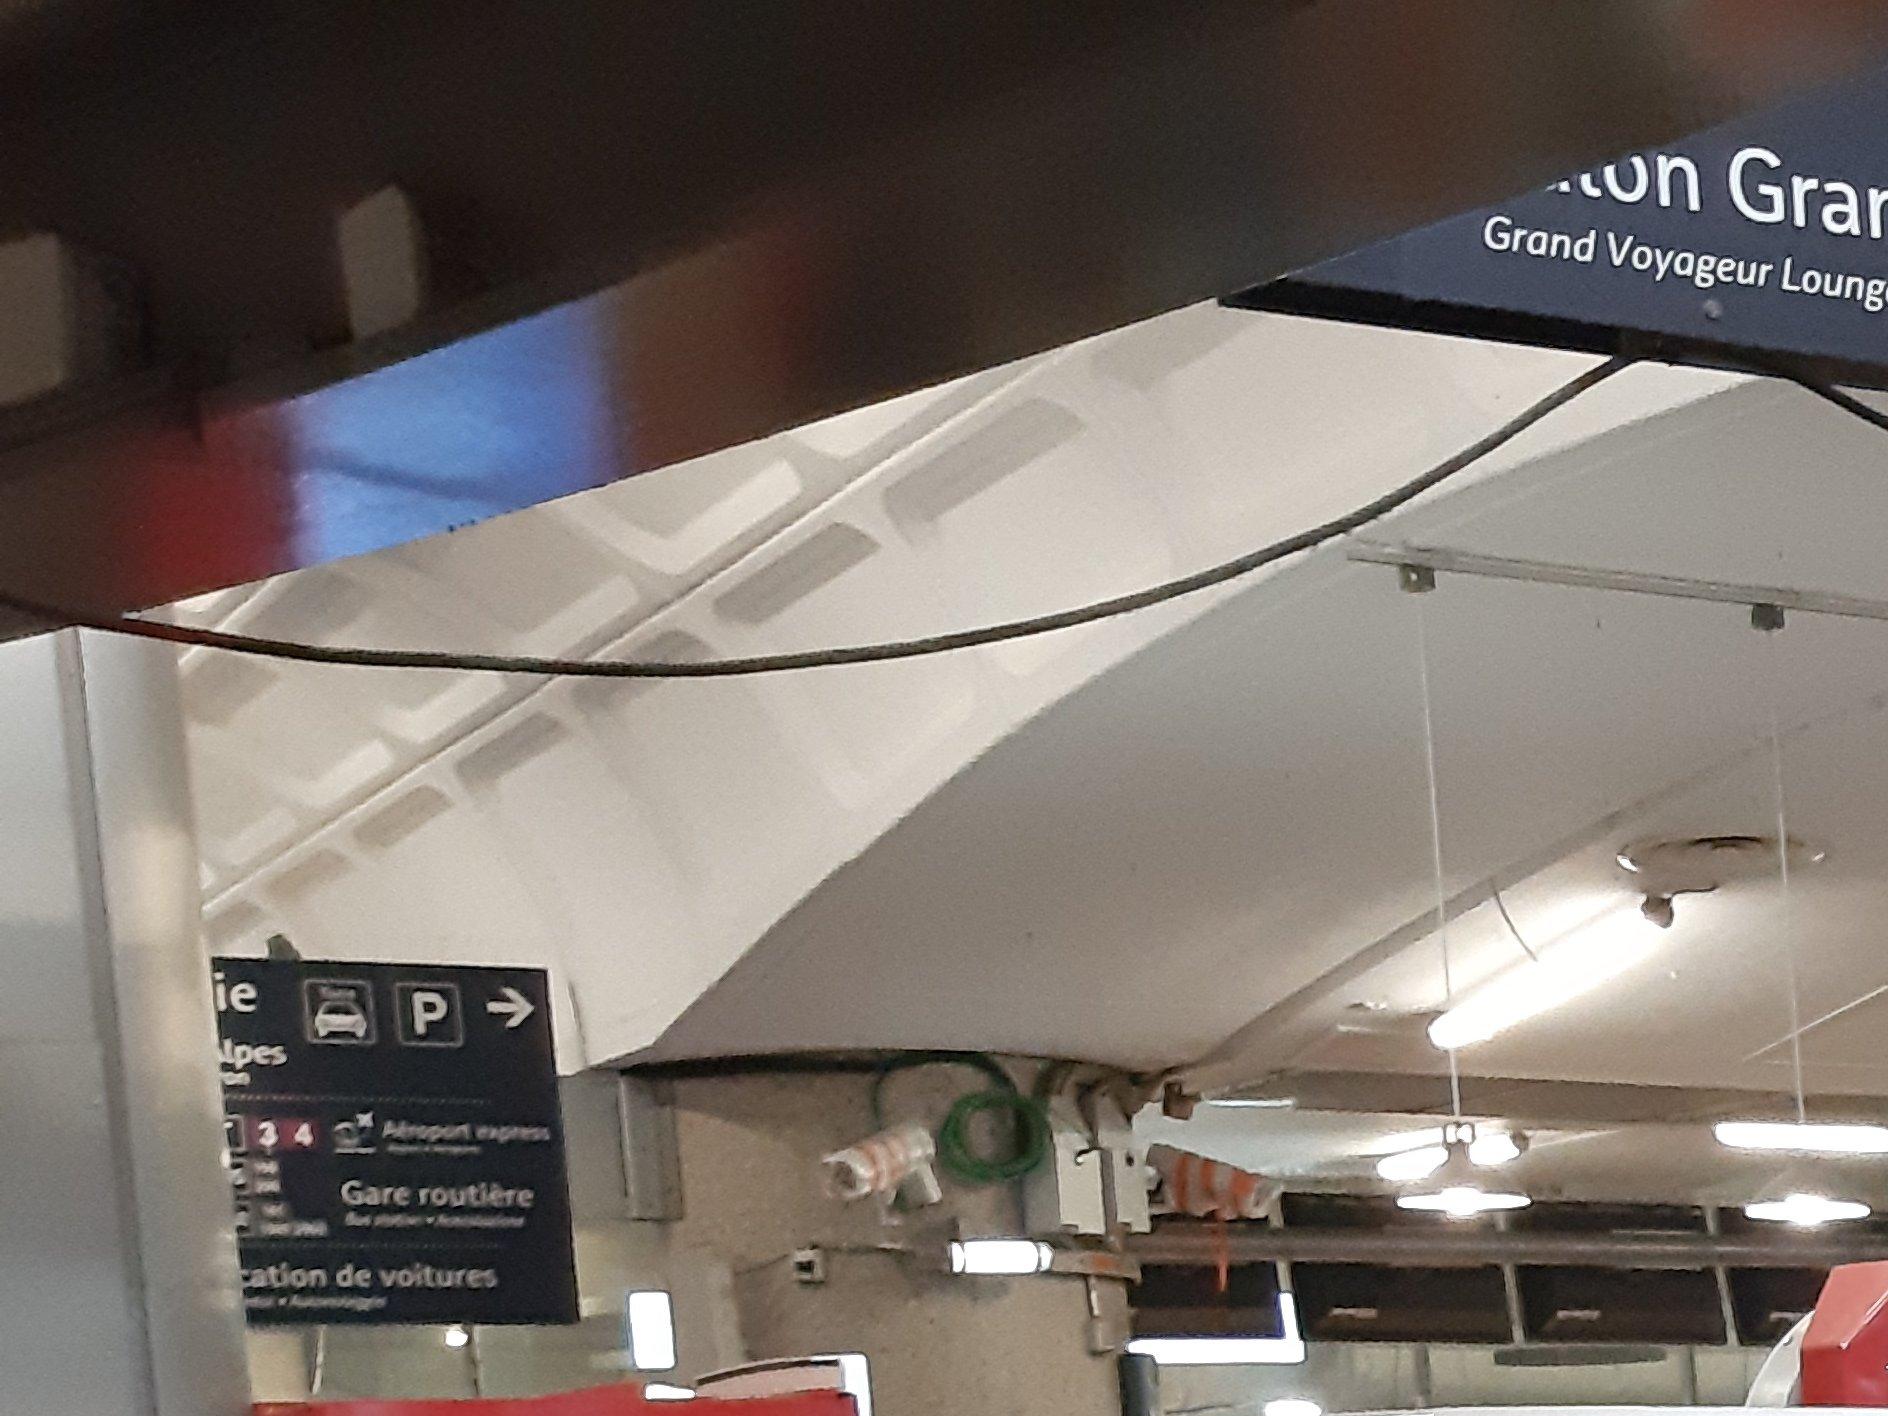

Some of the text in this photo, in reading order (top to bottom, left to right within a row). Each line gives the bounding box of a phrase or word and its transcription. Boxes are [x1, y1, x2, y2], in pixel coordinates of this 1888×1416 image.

[1485, 216, 1596, 261] Grand
[1608, 232, 1773, 287] Voyageur
[340, 1179, 535, 1209] Gare routière
[336, 1262, 373, 1289] de
[379, 1262, 498, 1289] voitures
